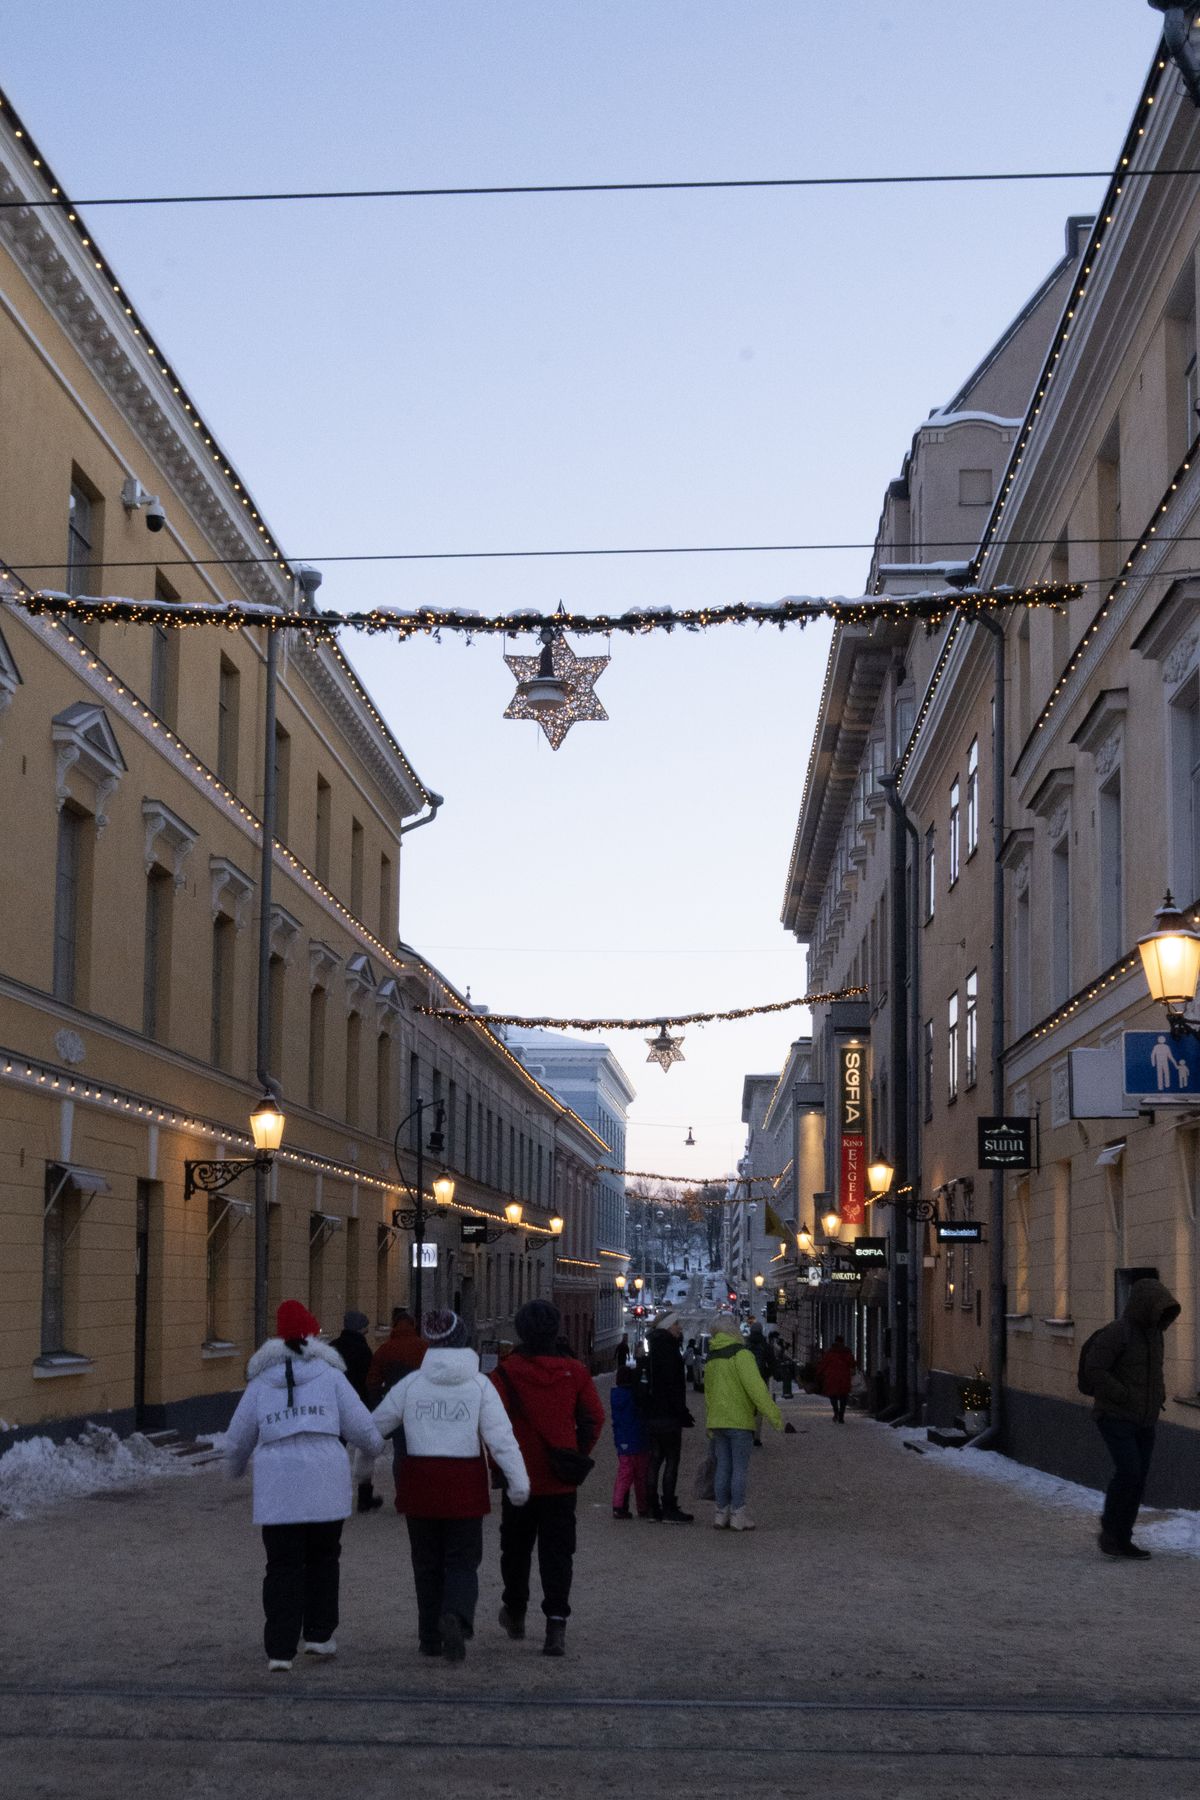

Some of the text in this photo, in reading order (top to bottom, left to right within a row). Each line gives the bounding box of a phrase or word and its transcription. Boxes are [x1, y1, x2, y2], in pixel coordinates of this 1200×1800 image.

[845, 1053, 860, 1124] SOFIA
[985, 1139, 1024, 1151] sunn
[847, 1149, 857, 1202] ENGEL
[855, 1248, 884, 1256] SOFIA
[266, 1405, 326, 1425] EXTREME
[415, 1399, 471, 1421] FILA
